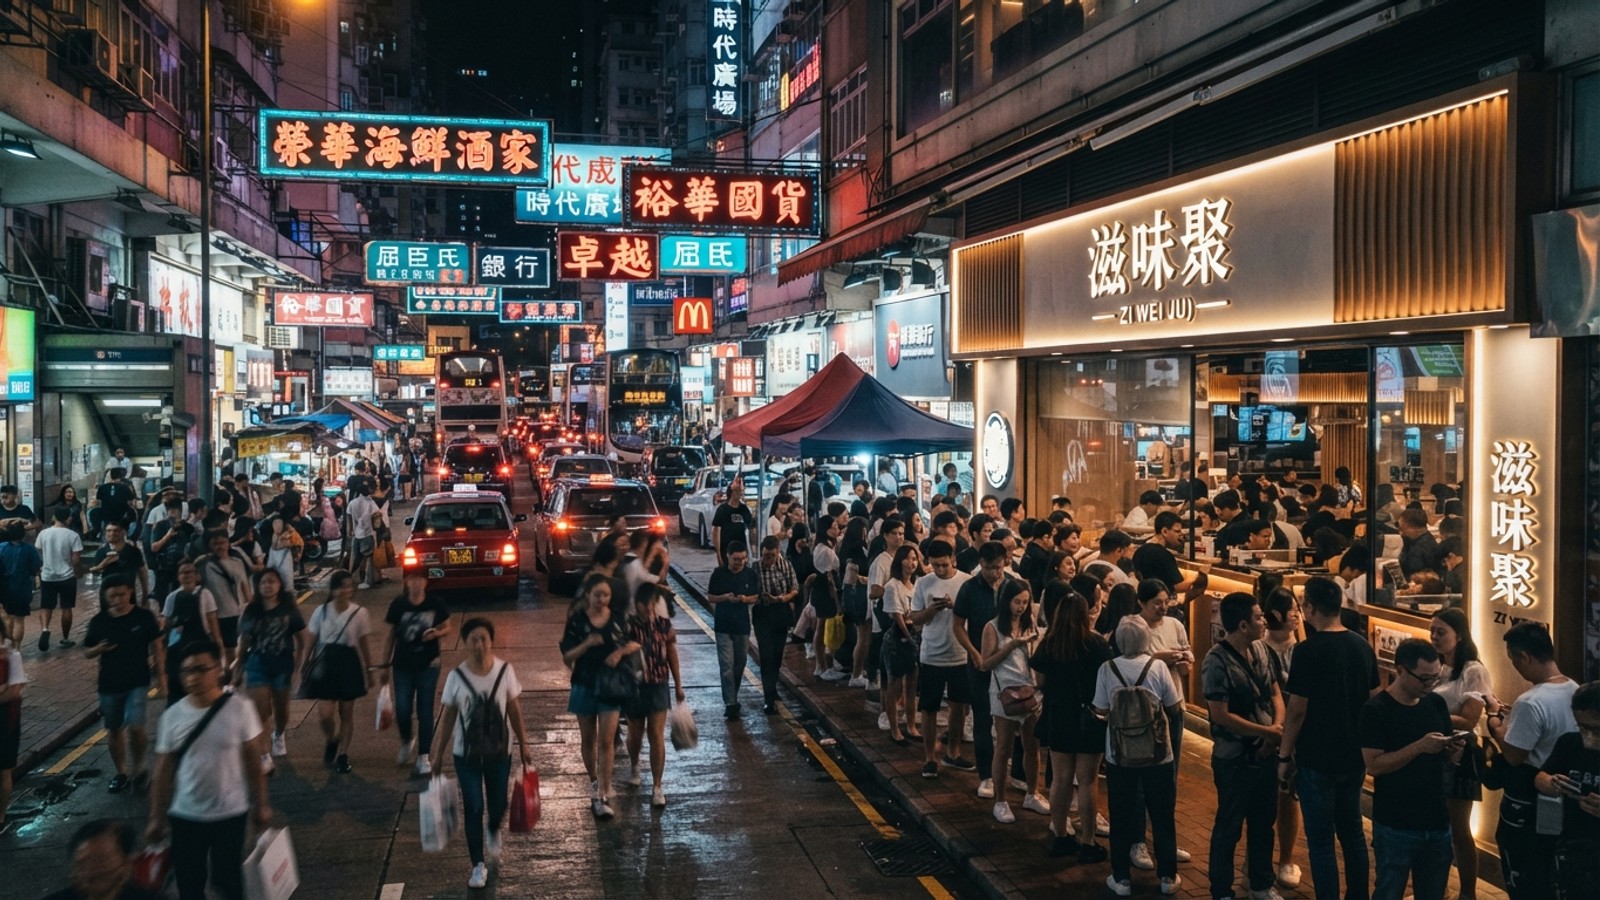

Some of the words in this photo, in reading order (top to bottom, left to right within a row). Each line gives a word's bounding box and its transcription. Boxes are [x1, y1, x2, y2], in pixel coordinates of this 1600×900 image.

[712, 6, 738, 116] 時代廣場
[273, 120, 538, 174] 榮華海鮮酒家
[635, 176, 806, 224] 裕華國貨
[376, 246, 460, 267] 屈臣氏
[481, 254, 538, 279] 銀行
[564, 235, 652, 278] 卓越
[1088, 197, 1232, 298] 滋味聚
[1120, 305, 1134, 325] ZI
[1136, 301, 1165, 323] WEI
[1490, 441, 1535, 608] 滋味聚
